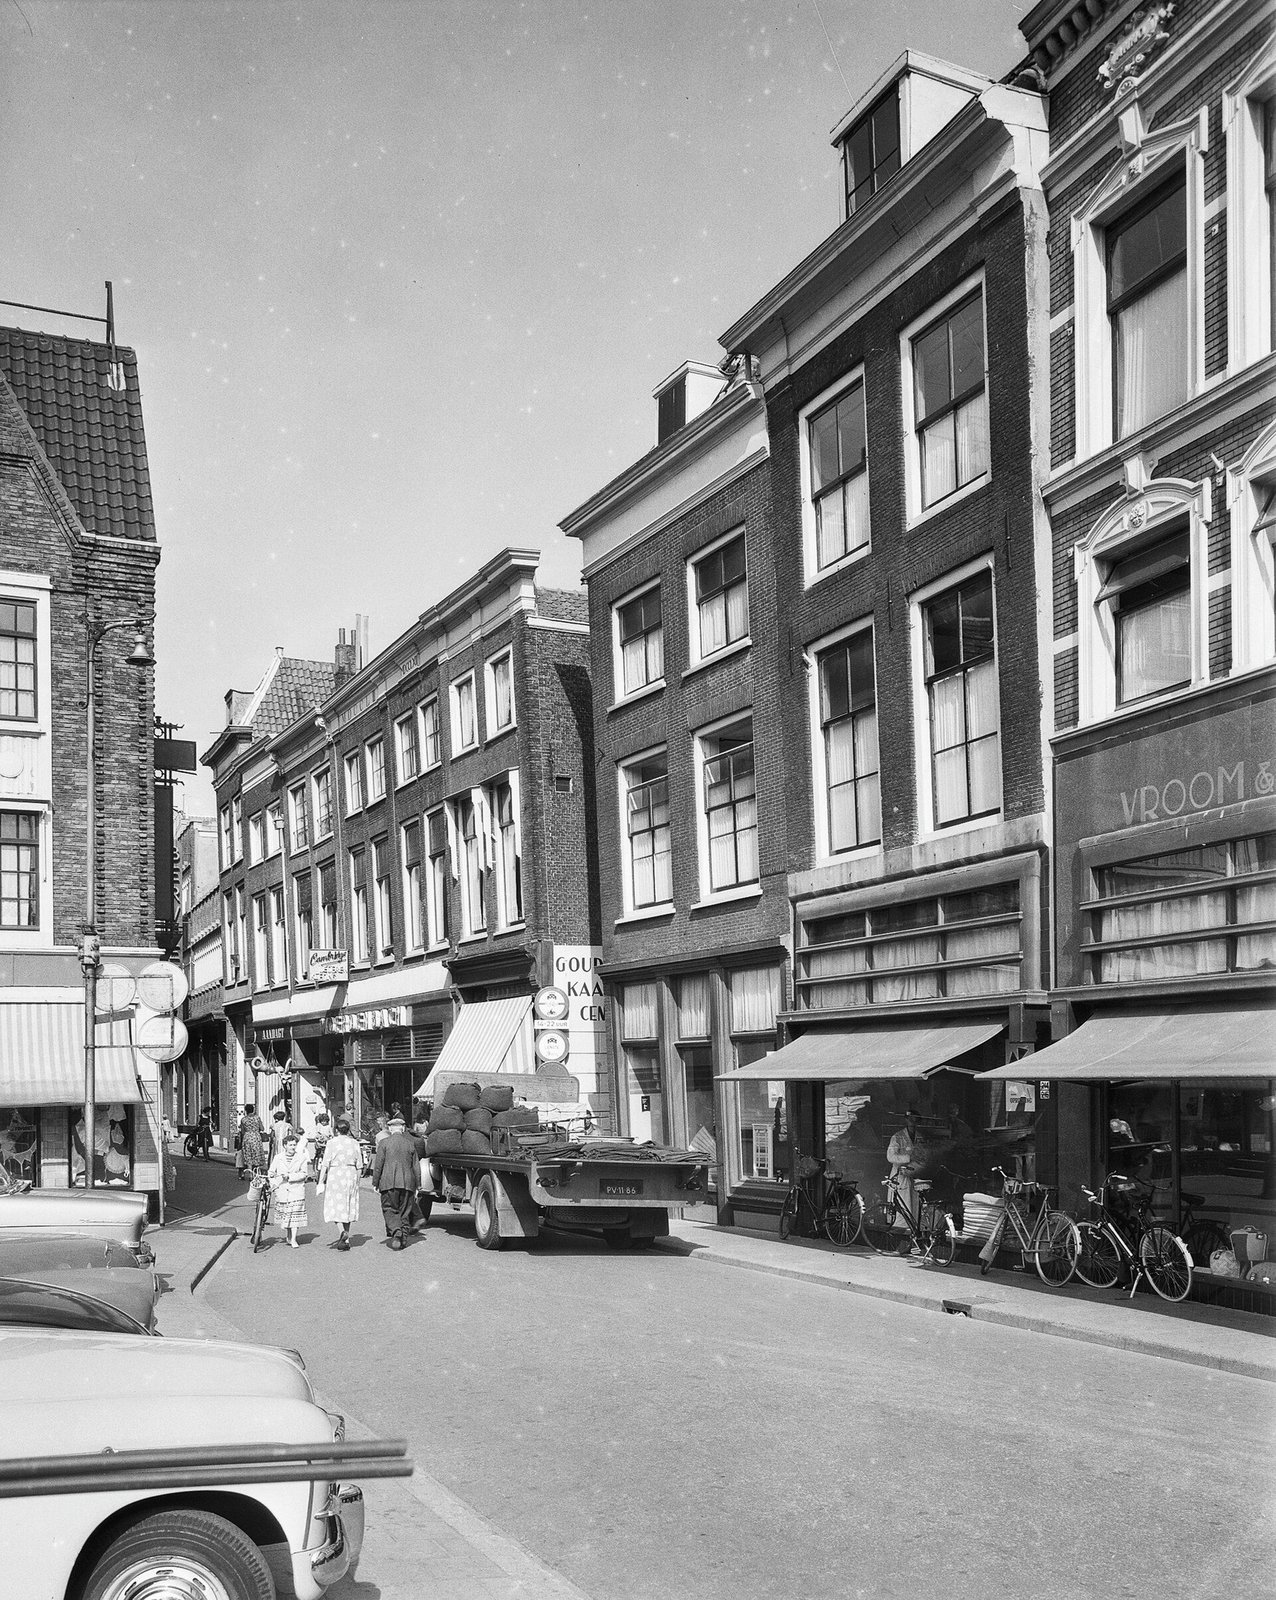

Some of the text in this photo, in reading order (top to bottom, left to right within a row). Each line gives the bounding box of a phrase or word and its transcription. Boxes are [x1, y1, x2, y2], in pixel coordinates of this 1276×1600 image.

[1120, 761, 1275, 826] VROOM &
[580, 1005, 606, 1021] CEN
